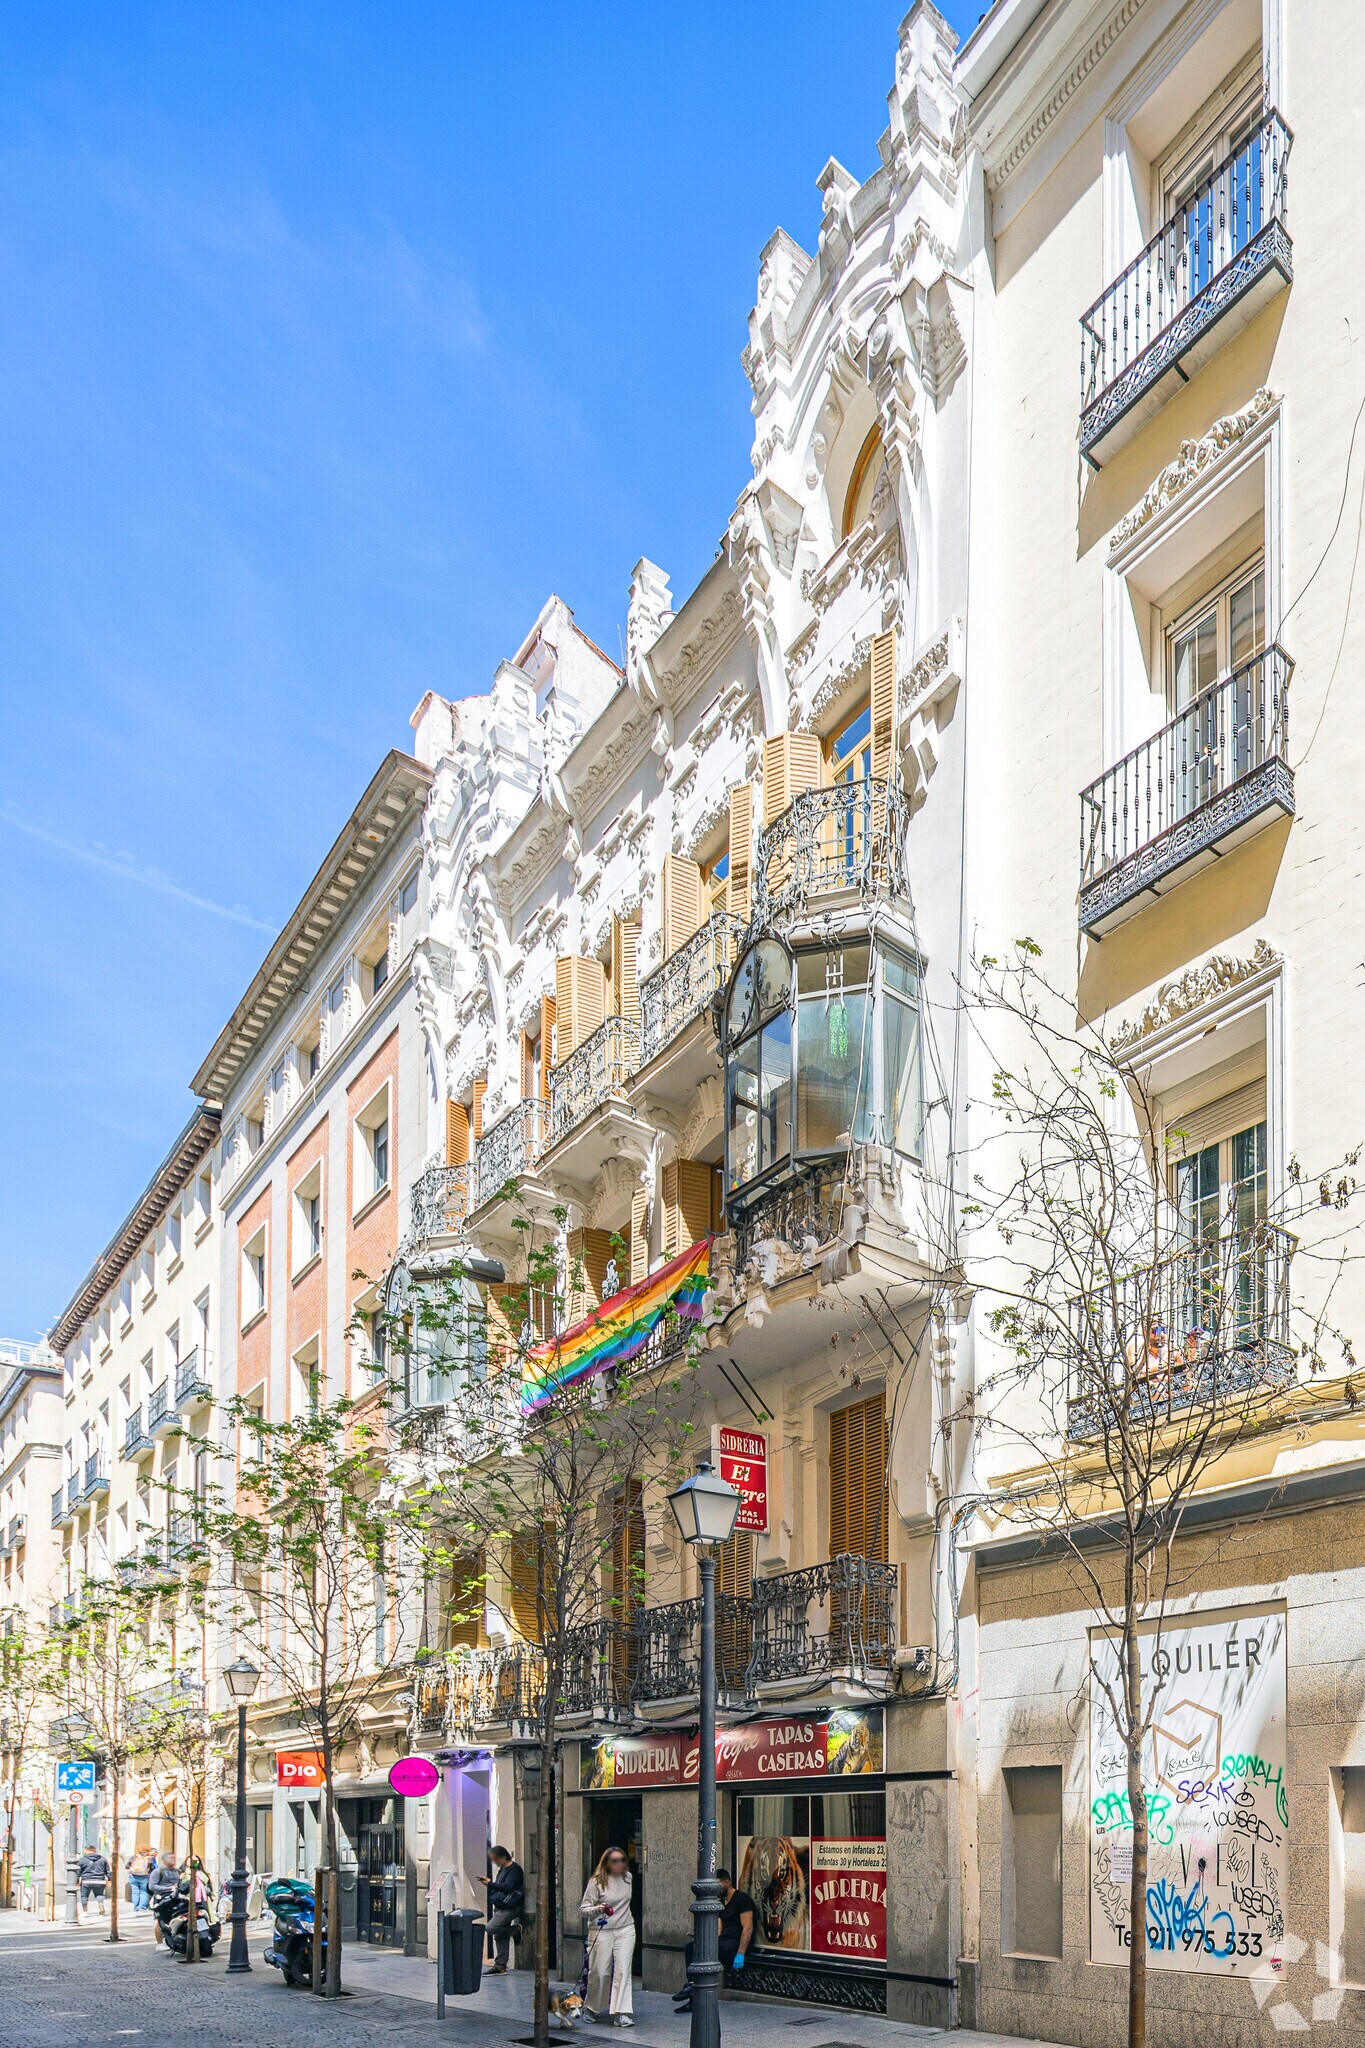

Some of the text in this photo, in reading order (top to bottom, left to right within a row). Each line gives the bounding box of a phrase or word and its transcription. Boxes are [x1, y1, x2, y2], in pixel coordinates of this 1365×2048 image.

[721, 1434, 764, 1456] SIDRERIA
[731, 1464, 750, 1482] El
[737, 1516, 764, 1526] SERAS
[738, 1509, 757, 1518] APAS
[1115, 1638, 1261, 1681] LQUILER
[767, 1724, 814, 1746] TAPAS
[616, 1734, 760, 1779] SIDRERIA E Tigre
[758, 1749, 825, 1773] CASERAS
[819, 1845, 842, 1854] Estamos
[852, 1845, 875, 1854] Infantas
[877, 1846, 885, 1855] 23,
[817, 1857, 838, 1866] Infantas
[840, 1858, 846, 1866] 30
[847, 1859, 851, 1868] y
[852, 1858, 879, 1867] Hortaleza
[814, 1878, 887, 1908] SIDRERIA
[834, 1909, 869, 1927] TAPAS
[826, 1930, 877, 1949] CASERAS
[1115, 1924, 1262, 1957] Te 911 975 533
